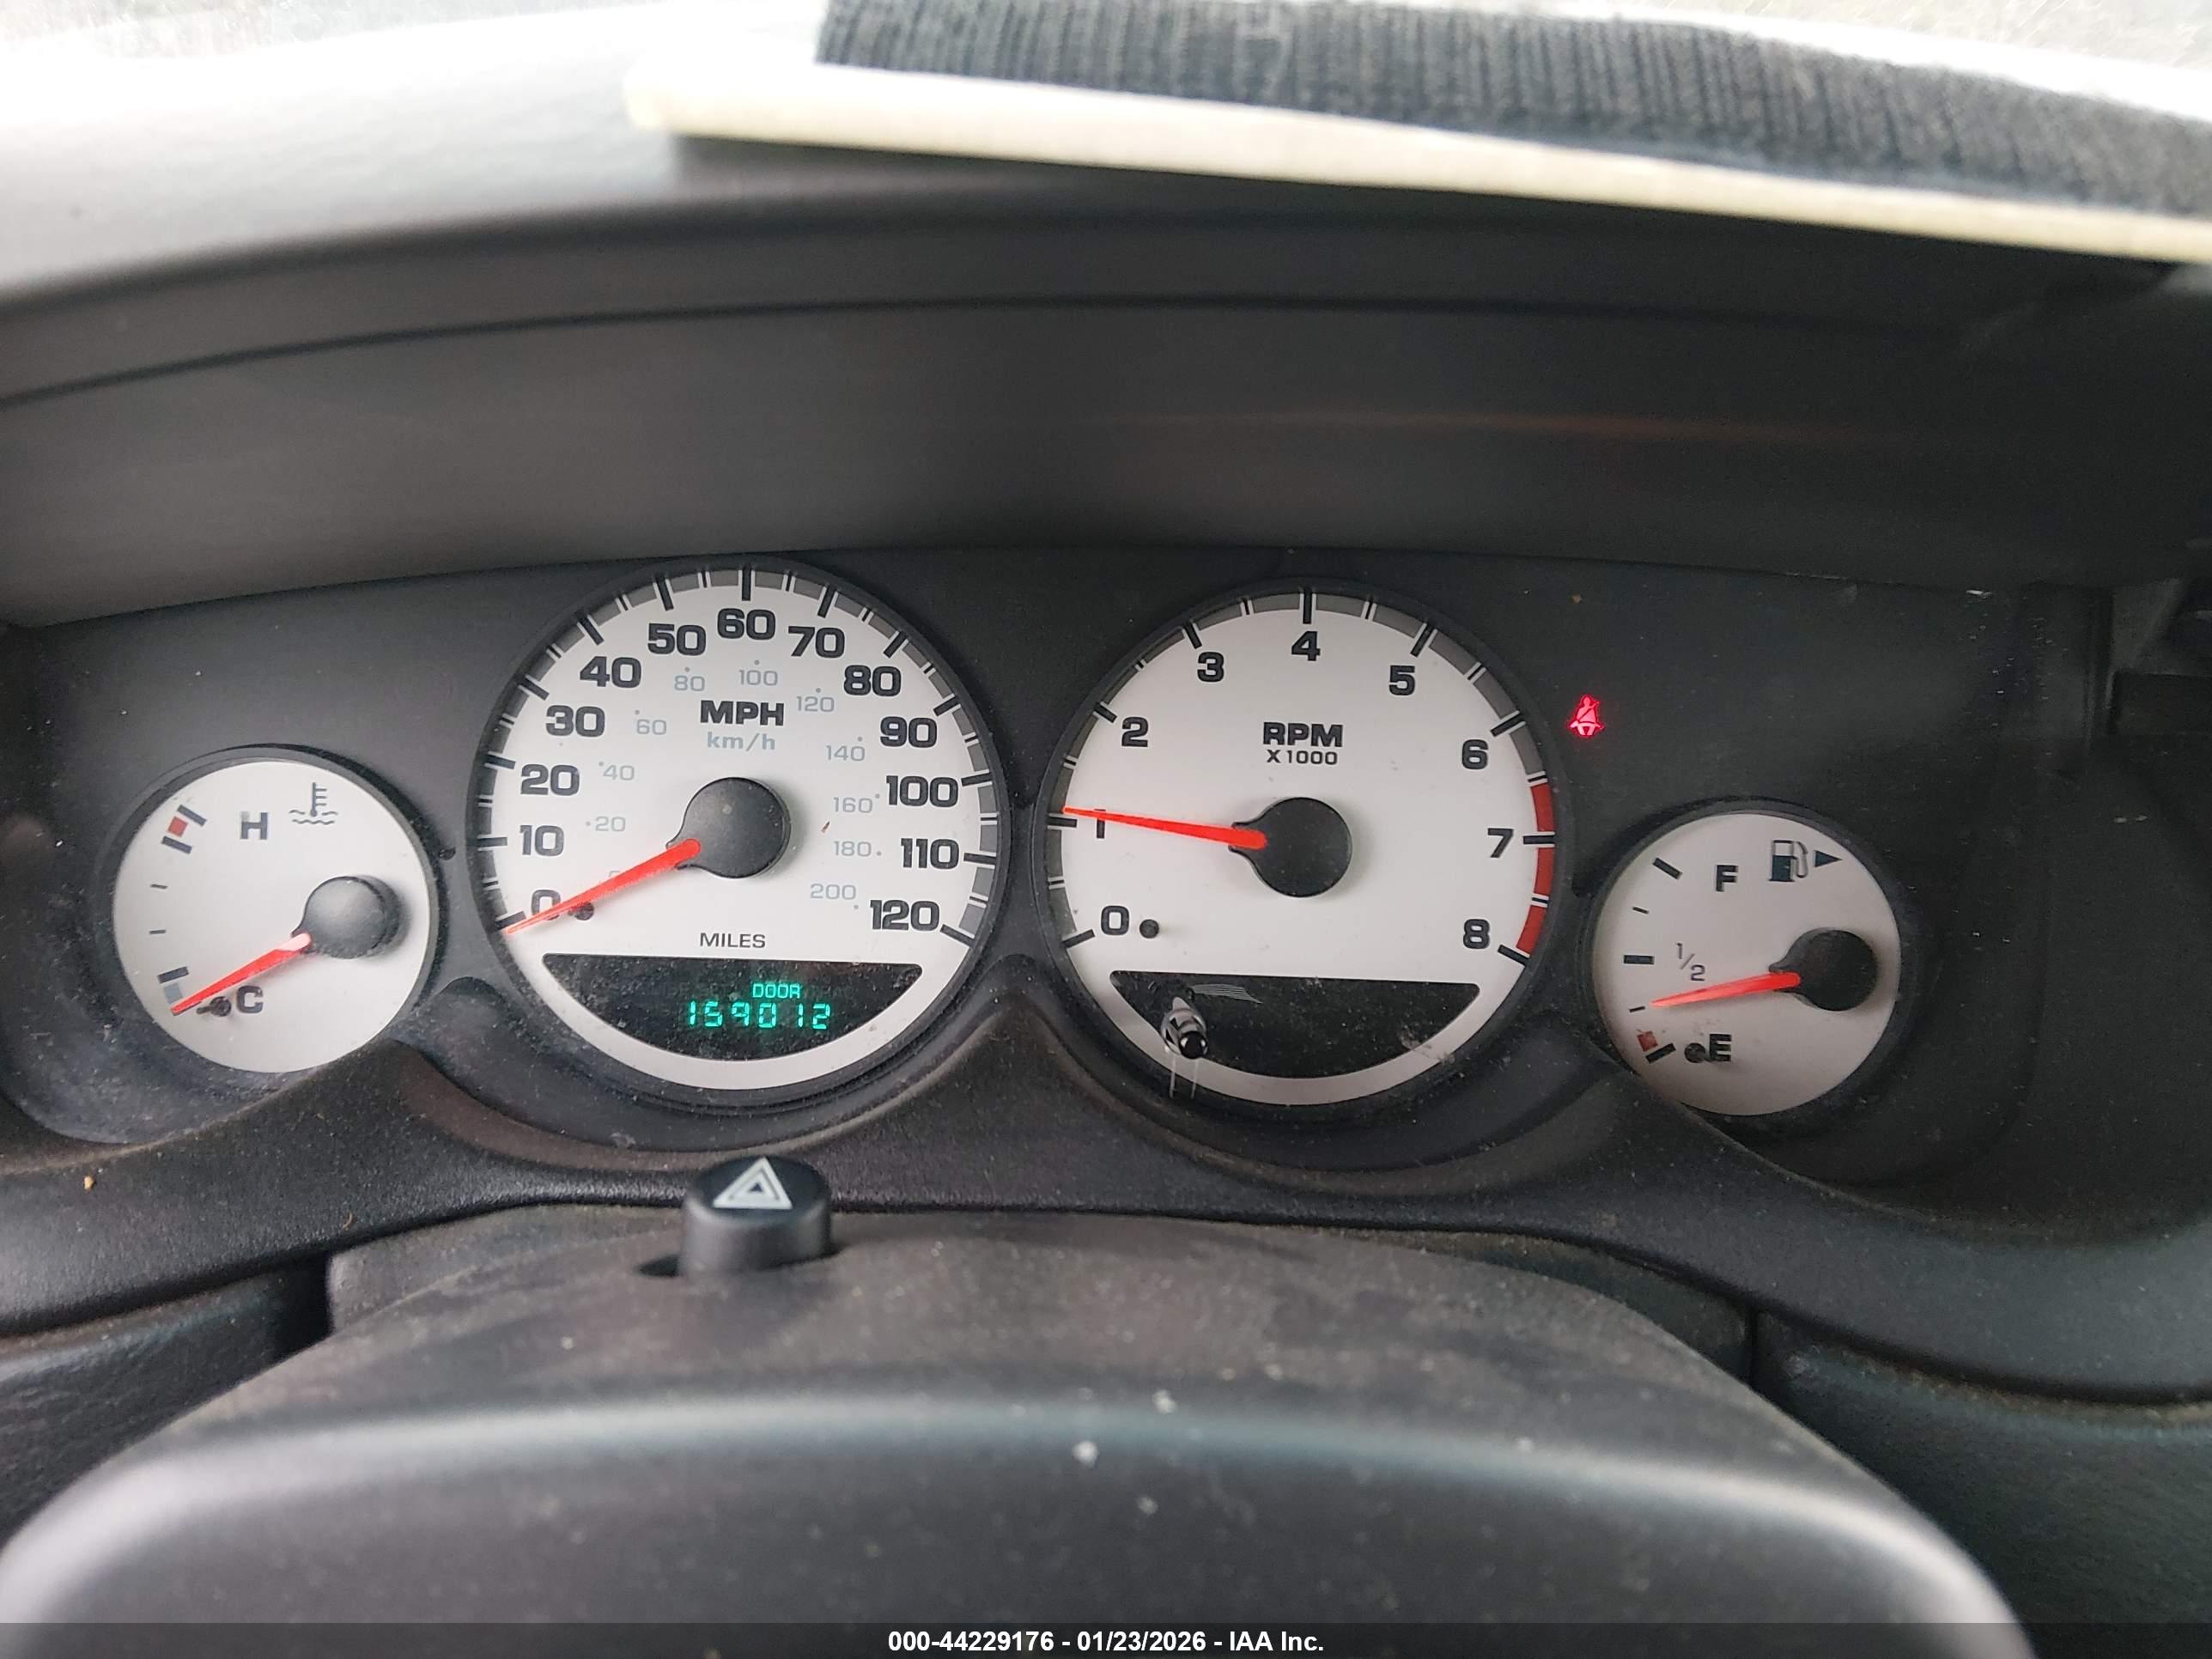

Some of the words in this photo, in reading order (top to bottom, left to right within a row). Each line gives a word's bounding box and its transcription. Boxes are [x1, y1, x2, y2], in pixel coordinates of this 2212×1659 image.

[647, 623, 706, 655] 50
[716, 609, 775, 640] 60
[787, 627, 845, 658] 70
[1291, 631, 1320, 660] 4
[580, 657, 641, 688] 40
[739, 669, 778, 686] 100
[843, 665, 902, 696] 80
[1197, 653, 1224, 682] 3
[1389, 665, 1416, 696] 5
[674, 674, 705, 691] 80
[700, 700, 784, 726] MPH
[796, 696, 835, 712] 120
[545, 706, 605, 738] 30
[636, 719, 667, 736] 60
[879, 717, 938, 748] 90
[1121, 717, 1148, 747] 2
[1263, 722, 1343, 747] RPM
[707, 732, 775, 751] km/h
[825, 744, 866, 762] 140
[1462, 739, 1488, 769] 6
[520, 764, 580, 796] 20
[602, 764, 635, 781] 40
[833, 797, 872, 813] 160
[885, 775, 958, 807] 100
[240, 811, 268, 840] H
[594, 816, 625, 832] 20
[1094, 809, 1106, 838] 1
[520, 825, 564, 856] 10
[834, 842, 872, 858] 180
[900, 839, 959, 869] 110
[1487, 828, 1514, 858] 7
[810, 883, 856, 900] 200
[1715, 865, 1738, 891] F
[532, 890, 561, 921] 0
[870, 900, 939, 931] 120
[1100, 905, 1130, 936] 0
[1463, 919, 1490, 948] 8
[700, 932, 766, 949] MILES
[1676, 942, 1705, 981] 1/2
[236, 986, 264, 1013] C
[752, 983, 801, 999] DOOR
[689, 1000, 830, 1030] 159012
[1709, 1033, 1732, 1062] E
